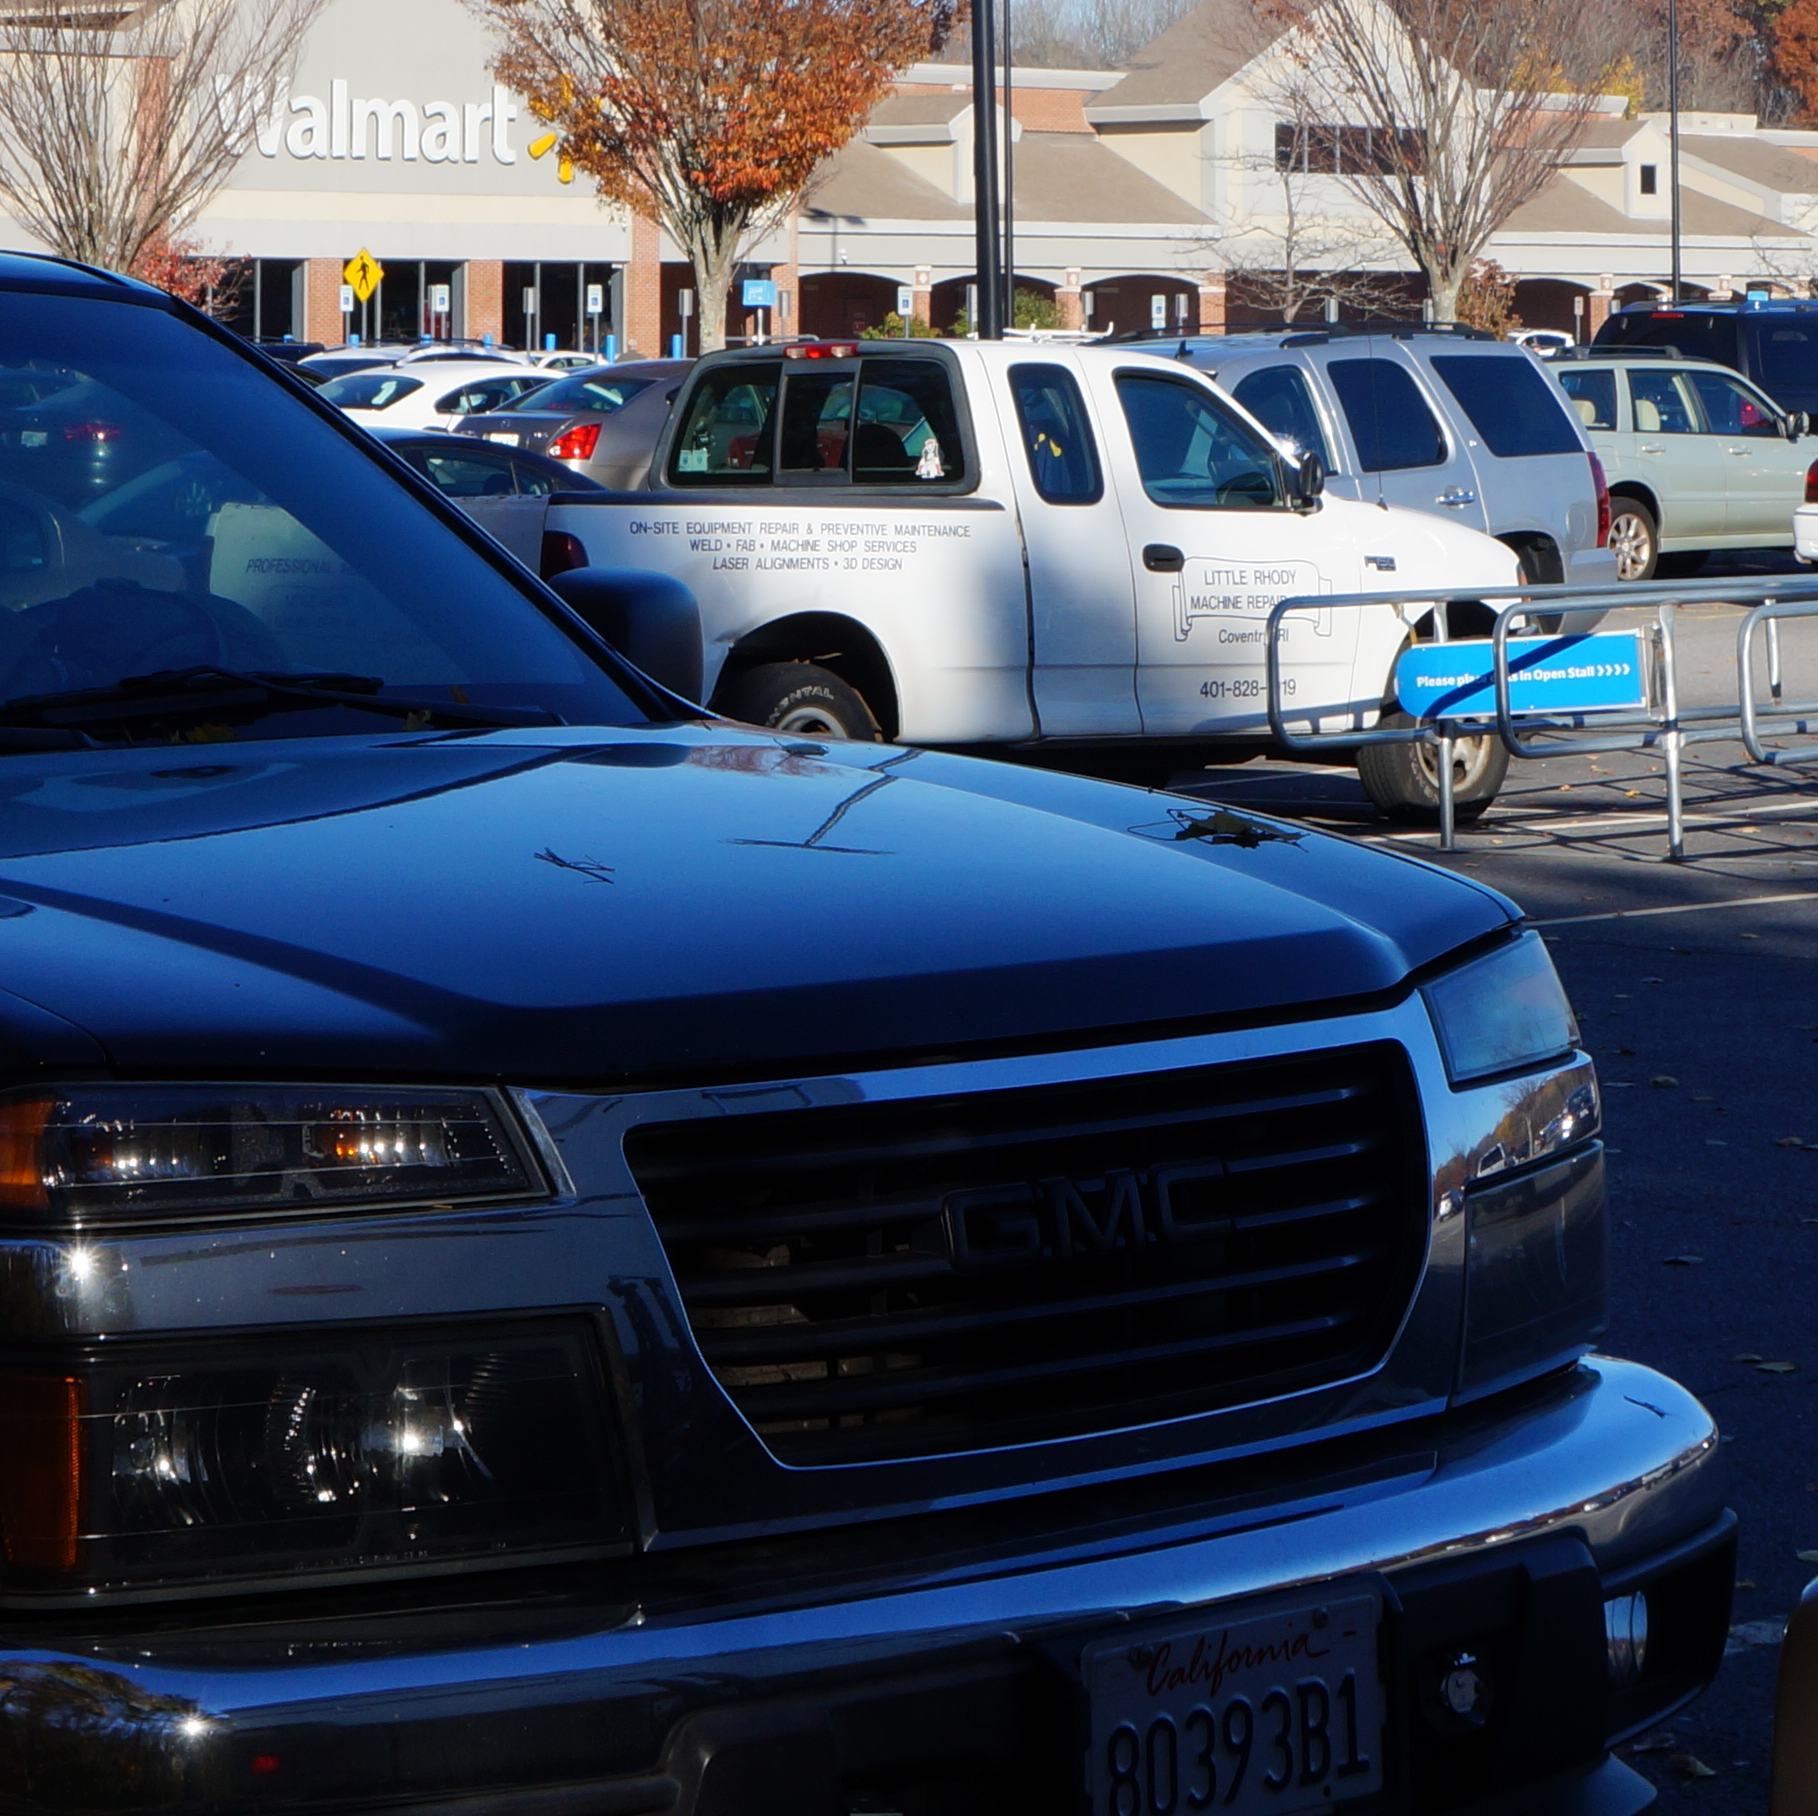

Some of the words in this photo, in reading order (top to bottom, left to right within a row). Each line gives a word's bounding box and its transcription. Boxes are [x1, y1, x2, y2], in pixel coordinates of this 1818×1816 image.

[213, 74, 517, 165] Walmart
[629, 521, 679, 534] ON-SITE
[686, 521, 753, 534] EQUIPMENT
[759, 522, 799, 534] REPAIR
[806, 522, 813, 535] &
[820, 523, 888, 535] PREVENTIVE
[894, 524, 971, 538] MAINTENANCE
[689, 539, 722, 552] WELD
[735, 539, 755, 552] FAB
[770, 539, 820, 552] MACHINE
[827, 539, 857, 552] SHOP
[863, 540, 917, 553] SERVICES
[712, 557, 749, 570] LASER
[755, 557, 829, 570] ALIGNMENTS
[843, 558, 857, 570] 3D
[862, 558, 903, 570] DESIGN
[1204, 570, 1247, 585] LITTLE
[1254, 570, 1296, 585] RHODY
[1190, 595, 1243, 610] MACHINE
[1219, 629, 1265, 644] Coventr
[1417, 675, 1455, 687] Please
[1520, 669, 1531, 681] in
[1533, 669, 1566, 682] Open
[1568, 665, 1595, 679] Stall
[1199, 679, 1296, 698] 401-828-19
[942, 1155, 1234, 1274] GMC
[1147, 1621, 1330, 1697] California
[1109, 1668, 1370, 1816] 80393B1
